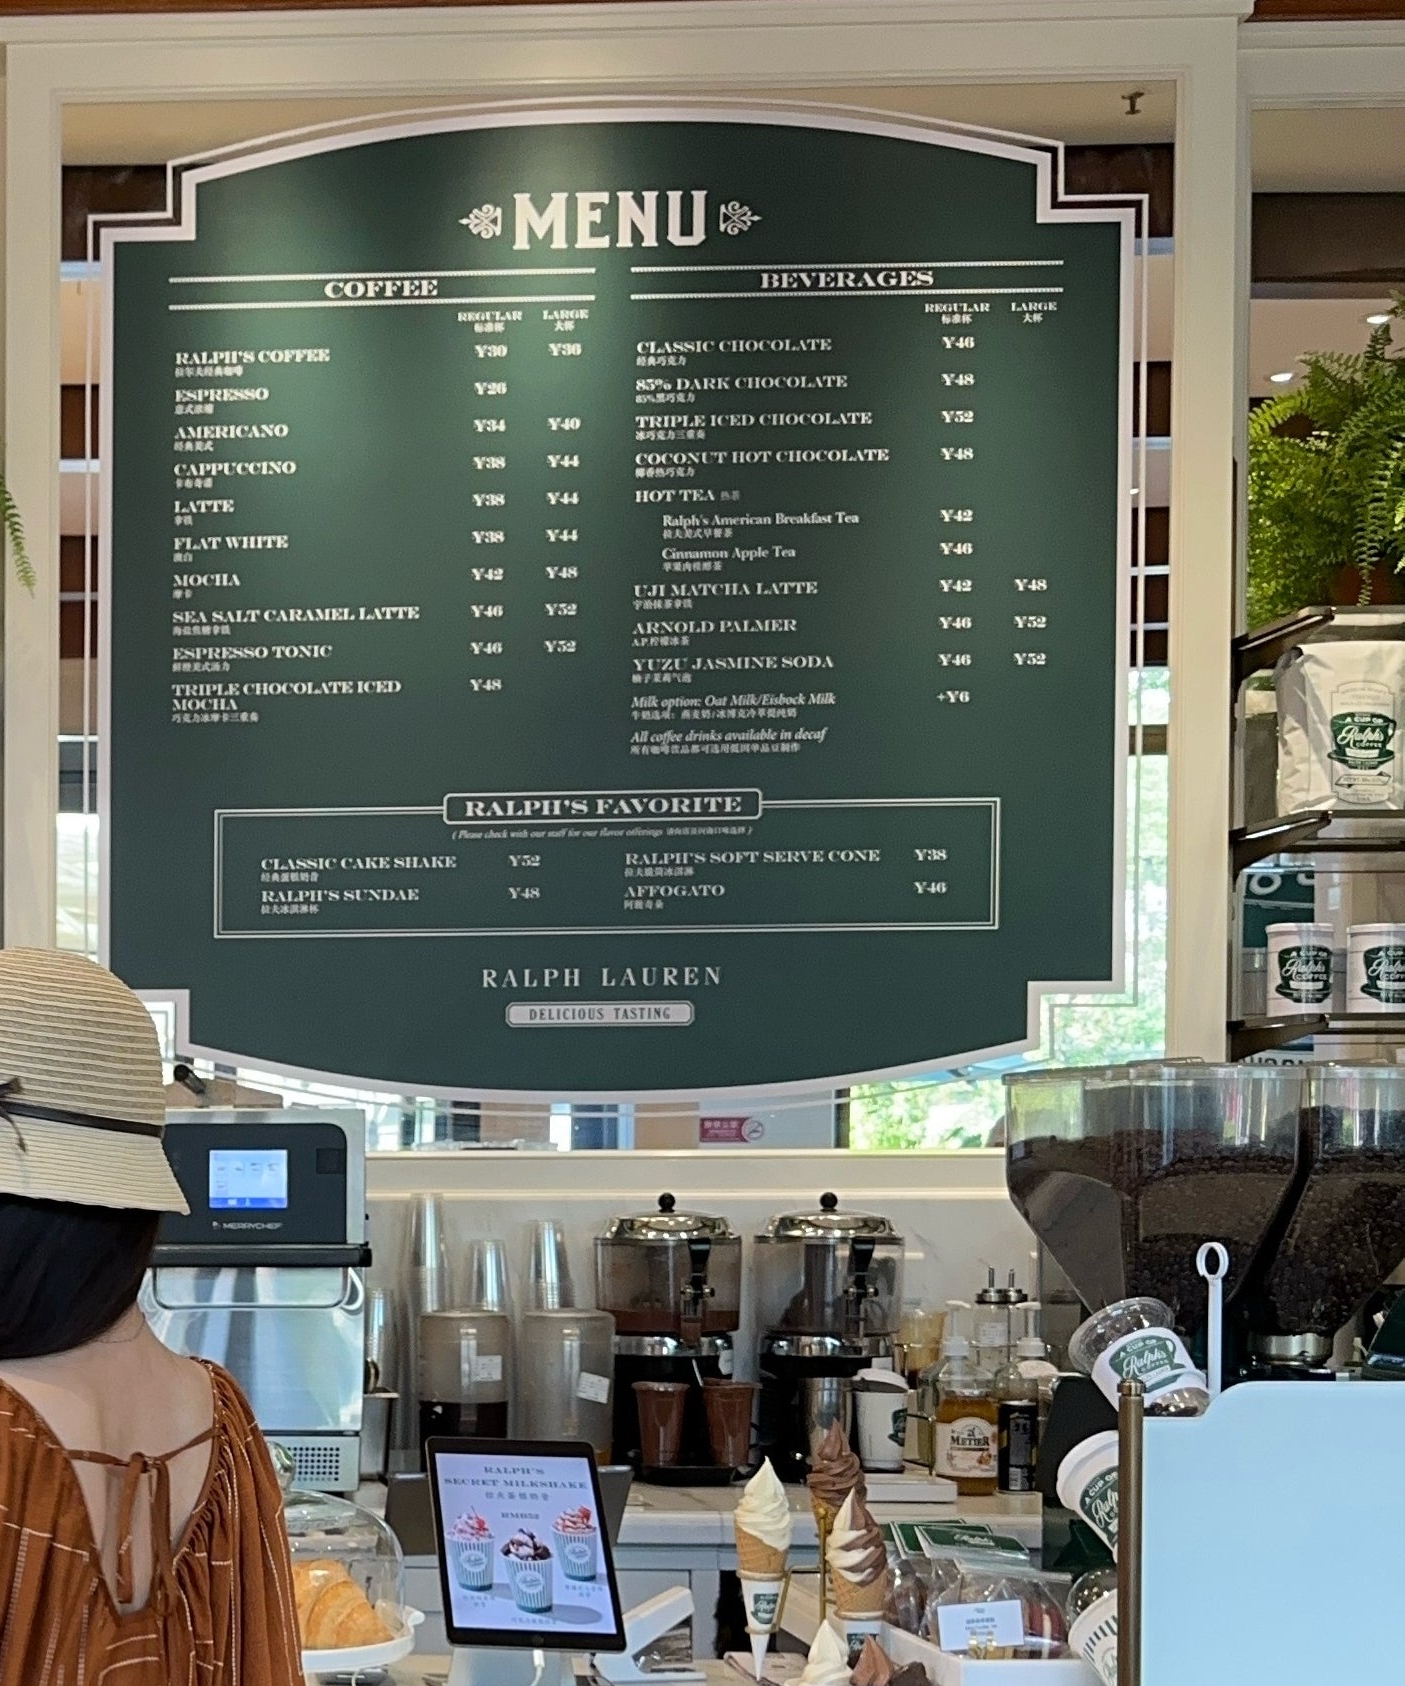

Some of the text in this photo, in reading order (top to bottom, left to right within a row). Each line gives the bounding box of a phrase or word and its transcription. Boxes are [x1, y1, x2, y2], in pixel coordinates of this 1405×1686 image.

[512, 190, 709, 250] MENU
[761, 271, 934, 288] BEVERAGES
[324, 279, 437, 298] COFFEE
[925, 302, 1057, 312] REGULAR LARGE
[458, 309, 588, 321] REGULAR LARGE
[637, 339, 832, 353] CLASSIC CHOCOLATE
[176, 349, 330, 366] RALPH'S COFFEE
[636, 375, 847, 391] 85% DARK CHOCOLATE
[175, 388, 269, 402] ESPRESSO
[635, 412, 872, 428] TRIPLE ICED CHOCOLATE
[174, 424, 288, 439] AMERICANO
[635, 449, 889, 465] COCONUT HOT CHOCOLATE
[174, 461, 296, 476] CAPPUCCINO
[636, 489, 715, 502] HOT TEA
[175, 499, 234, 513] LATTE
[663, 512, 859, 529] Ralph's American Breakfast Tea
[174, 535, 288, 550] FLAT WHITE
[662, 546, 796, 561] Cinnamon Apple Tea
[173, 574, 240, 587] MOCHA
[634, 582, 818, 597] UJI MATCHA LATTE
[173, 606, 420, 623] SEA SALT CARAMEL LATTE
[633, 619, 796, 634] ARNOLD PALMER
[173, 645, 332, 660] ESPRESSO TONIC
[633, 656, 833, 671] YUZU JASMINE SODA
[172, 680, 401, 696] TRIPLE CHOCOLATE ICED
[173, 698, 237, 711] MOCHA
[631, 692, 835, 710] Milk option: Oat Milk/Eisbock Milk
[630, 727, 828, 745] All coffee drinks available in decaf
[465, 797, 741, 816] RALPH'S FAVORITE
[261, 856, 456, 870] CLASSIC CAKE SHAKE
[626, 849, 880, 865] RALPH'S SOFT SERVE CONE
[262, 889, 419, 902] RALPH'S SUNDAE
[624, 885, 725, 897] AFFOGATO
[483, 967, 720, 988] RALPH LAUREN
[529, 1006, 671, 1021] DELICIOUS TASTING
[484, 1466, 545, 1475] RALPH'S
[444, 1478, 588, 1489] SECRET MILKSHAKE
